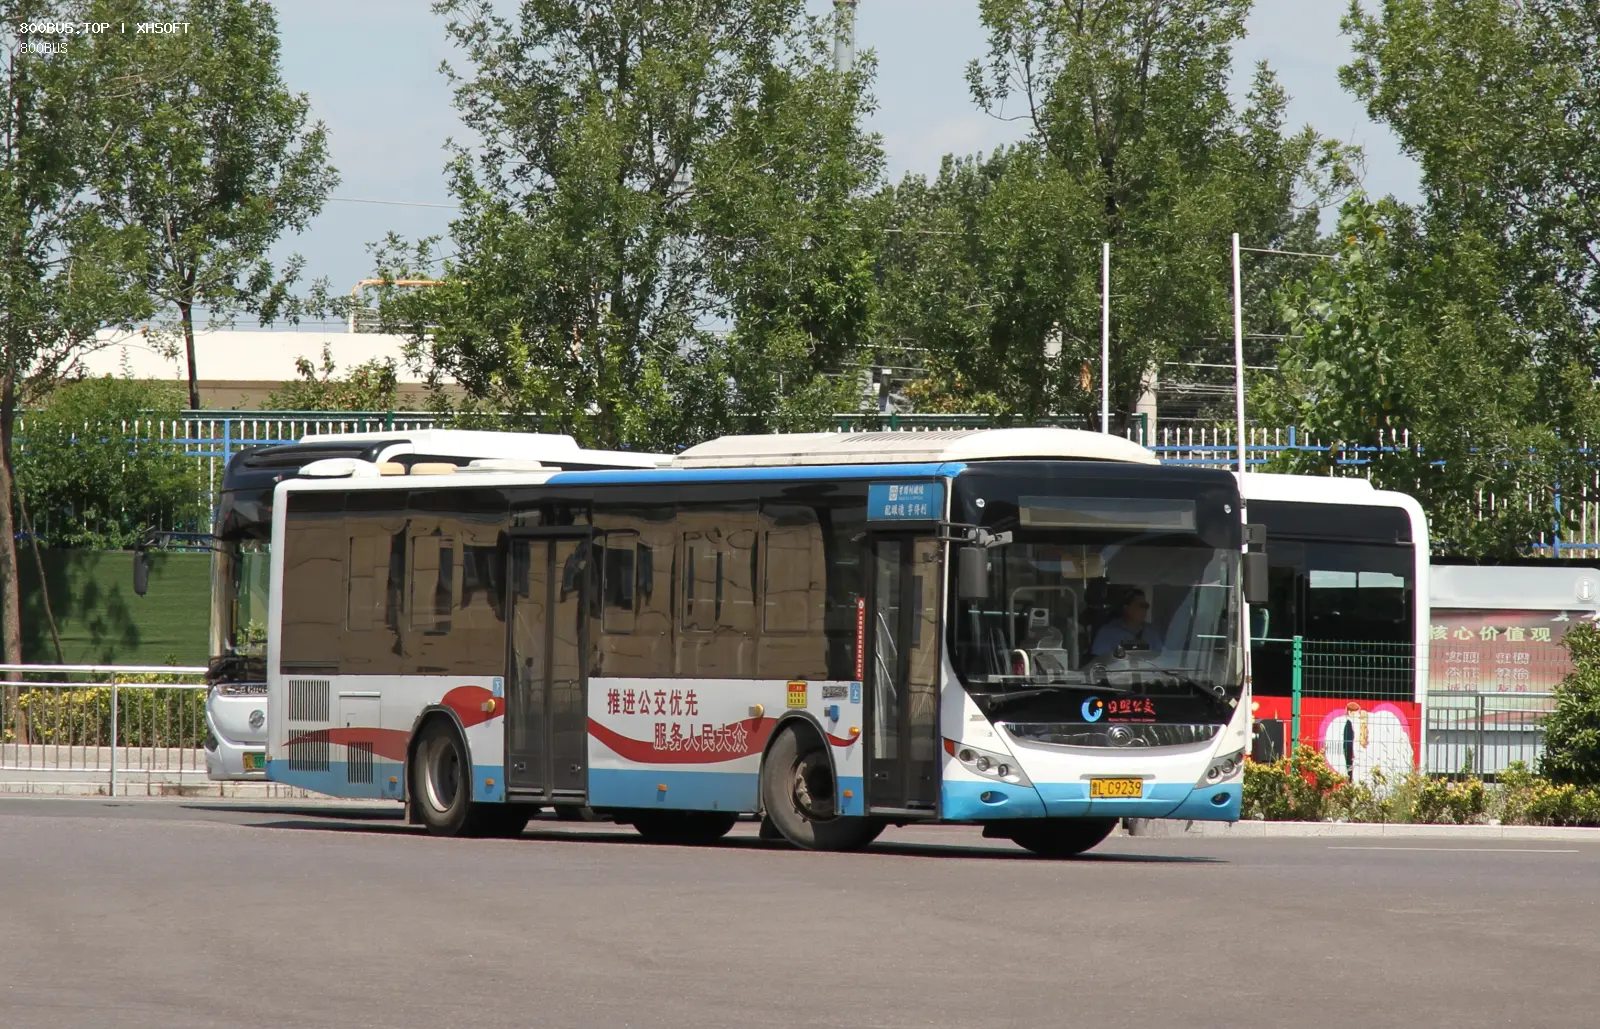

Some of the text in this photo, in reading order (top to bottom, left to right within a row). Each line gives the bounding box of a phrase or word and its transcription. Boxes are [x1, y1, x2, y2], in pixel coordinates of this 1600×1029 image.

[1430, 624, 1551, 643] 核心价值观
[607, 688, 699, 716] 推进公交优先
[1108, 698, 1157, 715] 日照公交
[653, 721, 749, 753] 服务人民大众
